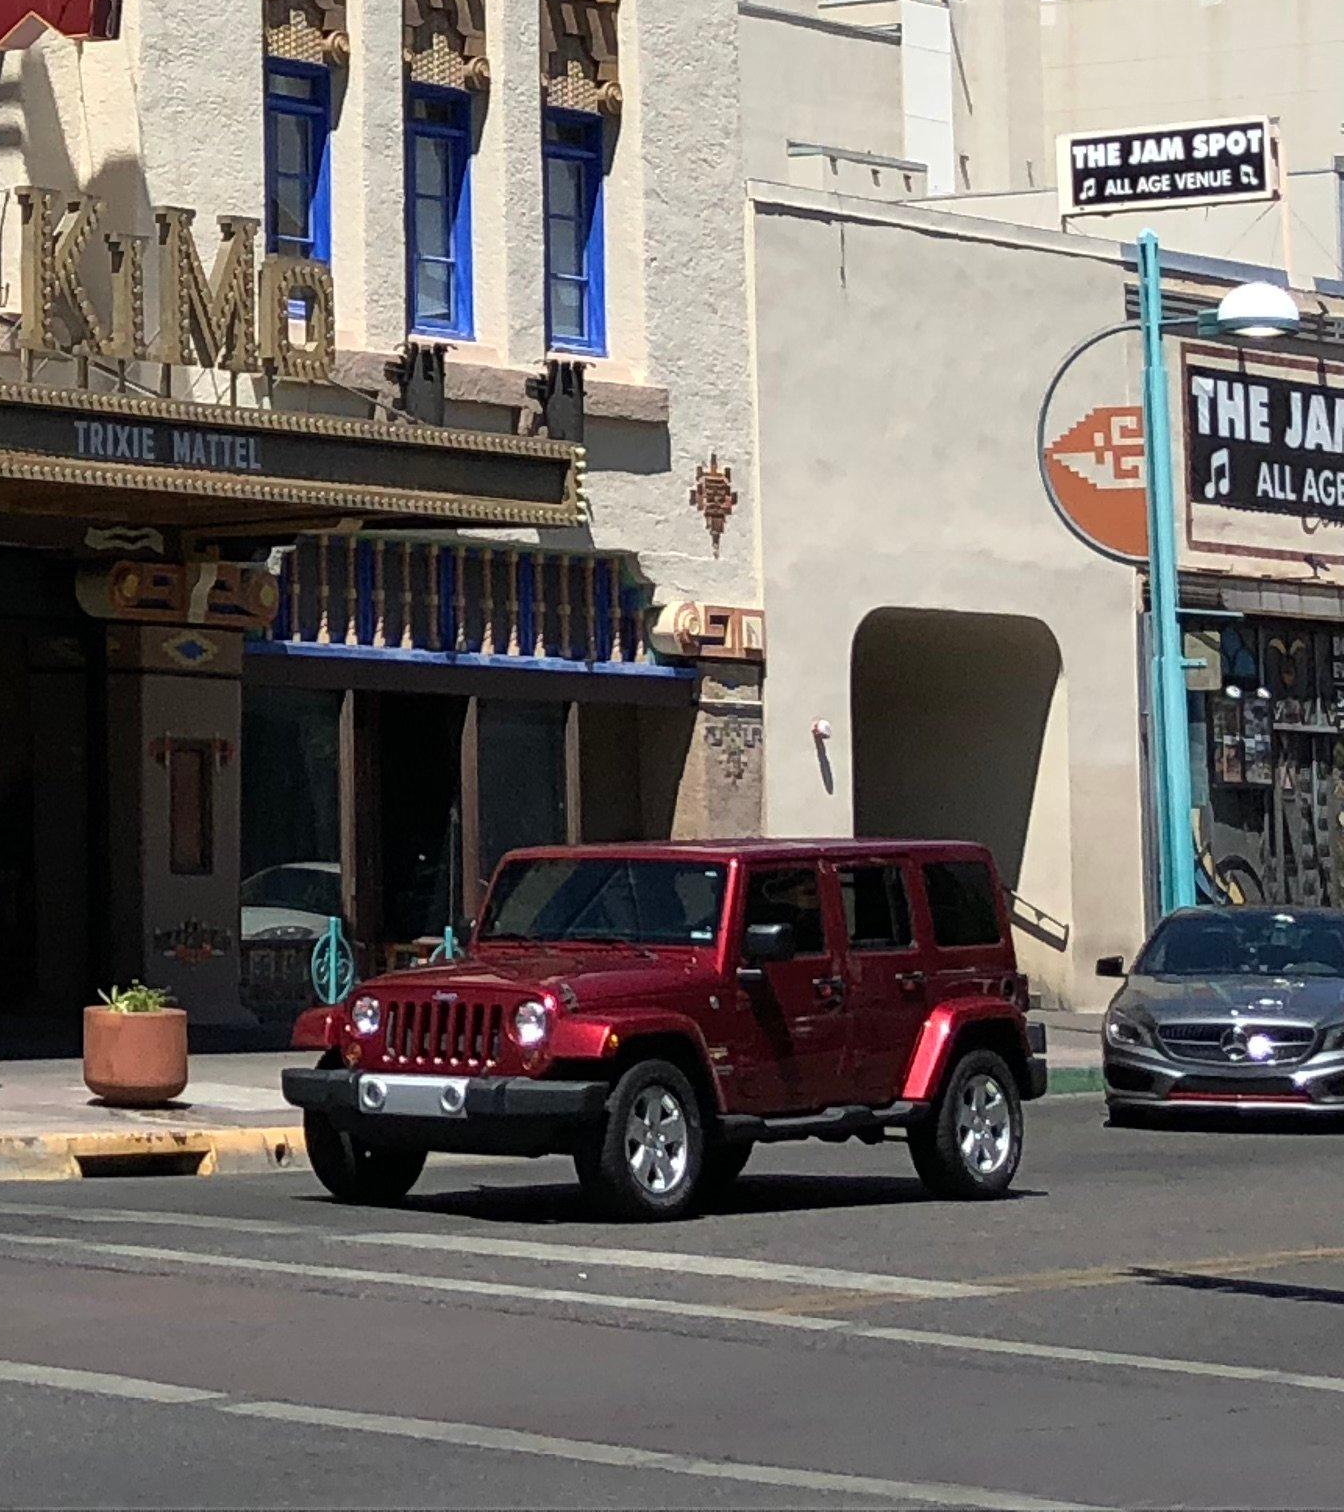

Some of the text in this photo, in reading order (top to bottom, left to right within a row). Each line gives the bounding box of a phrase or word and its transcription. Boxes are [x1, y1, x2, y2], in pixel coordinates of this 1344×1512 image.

[1072, 128, 1263, 170] THE JAM SPOT
[1104, 168, 1232, 197] ALL AGE VENUE
[1191, 375, 1272, 444] THE
[74, 421, 261, 471] TRIXIE MATTEL
[1256, 461, 1344, 507] ALL AGE
